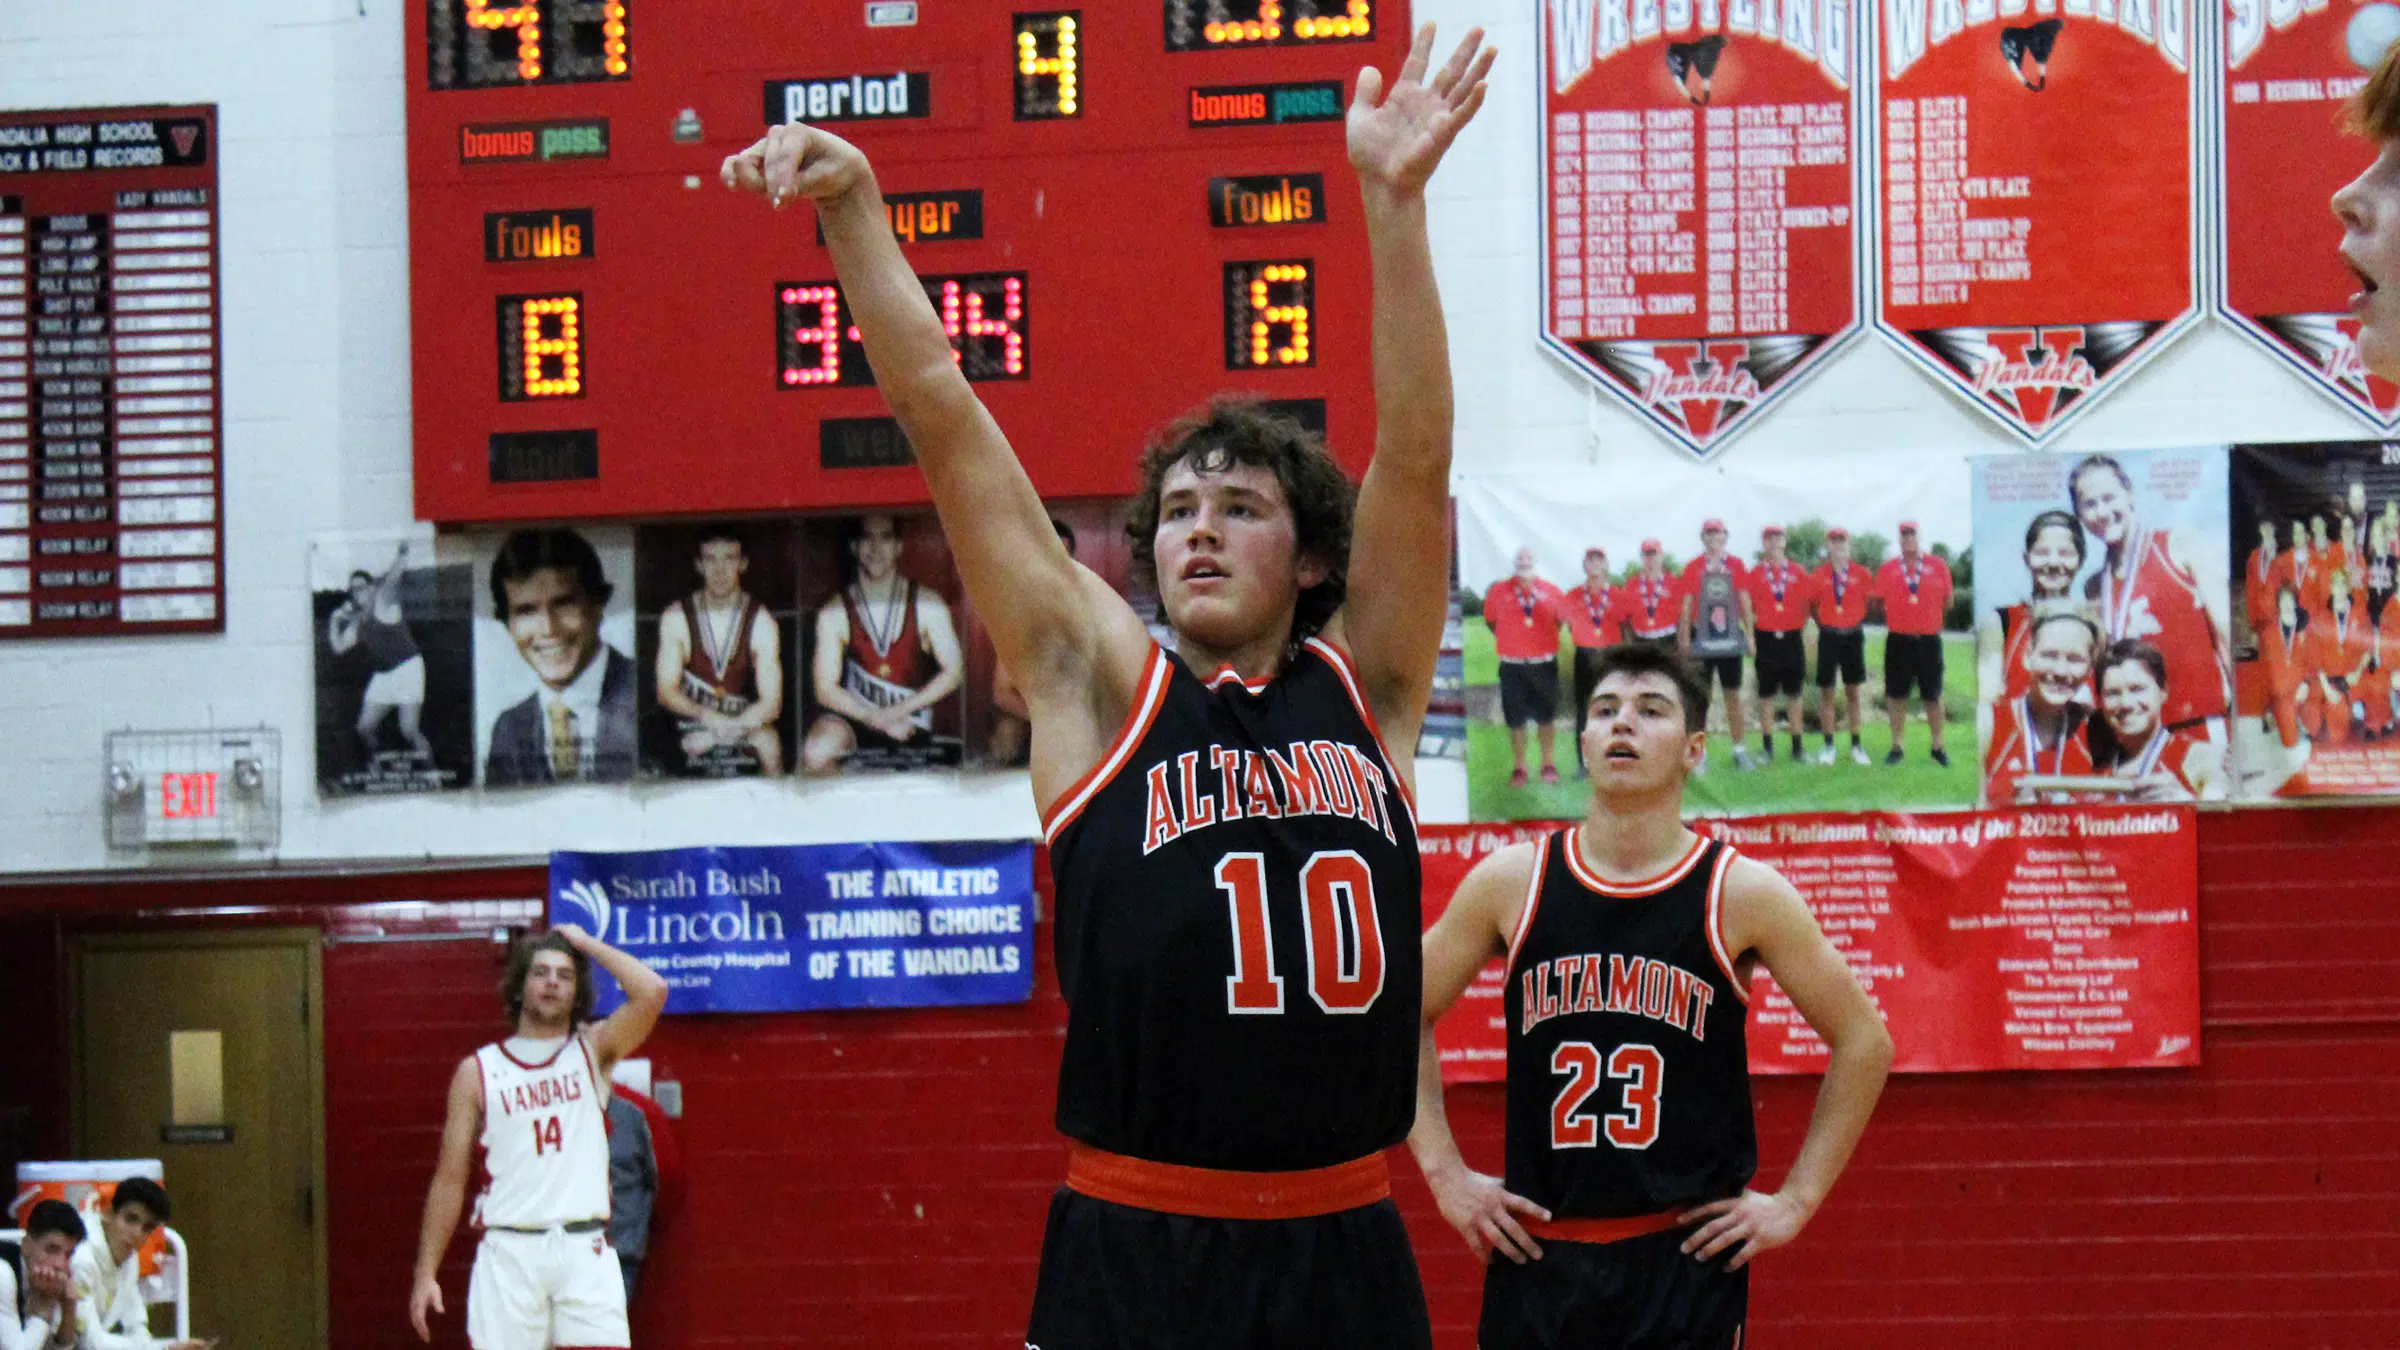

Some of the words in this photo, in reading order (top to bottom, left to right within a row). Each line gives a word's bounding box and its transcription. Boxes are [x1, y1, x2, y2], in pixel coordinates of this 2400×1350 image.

[1016, 13, 1078, 117] 4
[785, 71, 908, 127] period
[1191, 90, 1267, 122] bonus
[462, 127, 535, 159] bonus
[1224, 178, 1313, 226] fouls
[496, 213, 582, 259] fouls
[1250, 264, 1309, 366] 6
[523, 295, 582, 398] 8
[162, 771, 219, 820] EXIT
[1142, 738, 1398, 857] ALTAMONT
[1778, 821, 1868, 843] Platinum
[1873, 817, 1959, 846] Sponsors
[1962, 818, 1981, 848] of
[1984, 817, 2015, 841] the
[2019, 812, 2071, 837] 2022
[611, 868, 697, 900] Sarah
[706, 867, 783, 897] Bush
[826, 869, 874, 899] THE
[882, 867, 999, 897] ATHLETIC
[615, 899, 785, 944] Lincoln
[806, 908, 922, 940] TRAINING
[929, 904, 1022, 936] CHOICE
[1214, 849, 1387, 1016] 10
[2025, 928, 2054, 942] Long
[672, 953, 723, 970] County
[723, 950, 791, 971] Hospital
[809, 952, 840, 980] OF
[847, 949, 895, 978] THE
[903, 946, 1020, 977] VANDALS
[2024, 973, 2044, 986] The
[1521, 953, 1715, 1043] ALTAMONT
[499, 1071, 583, 1118] VANDALS
[1551, 1040, 1665, 1151] 23
[532, 1114, 565, 1157] 14
